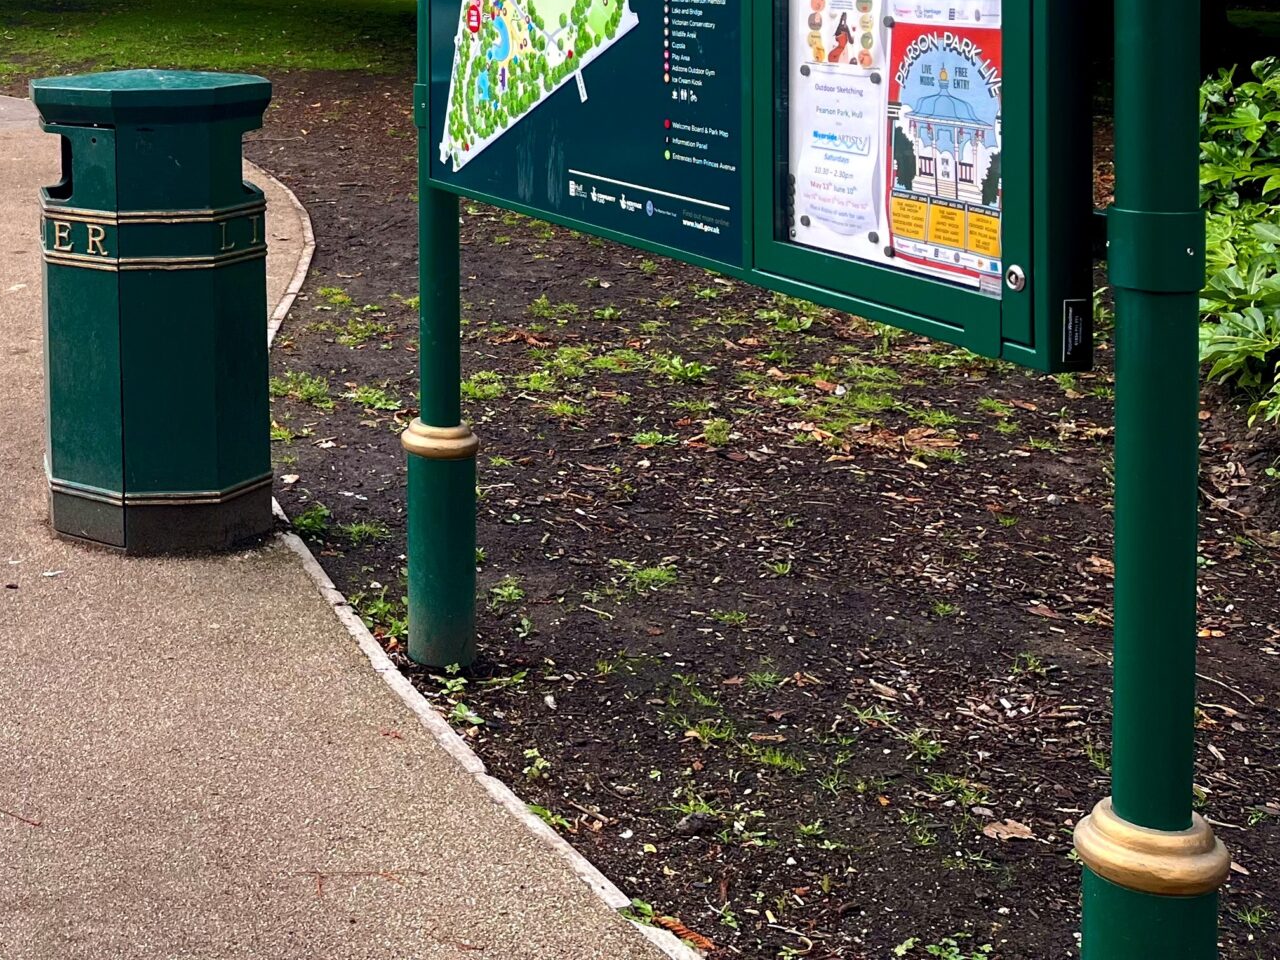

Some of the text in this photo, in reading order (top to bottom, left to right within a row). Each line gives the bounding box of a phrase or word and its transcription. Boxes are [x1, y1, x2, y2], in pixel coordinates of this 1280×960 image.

[894, 31, 1002, 98] PEARSON PARK LIVE
[922, 64, 932, 74] LIVE
[954, 67, 968, 77] FREE
[953, 79, 970, 89] ENTRY
[815, 83, 863, 97] Outdoor Sketching
[719, 162, 736, 172] Avenue
[42, 220, 108, 256] ER
